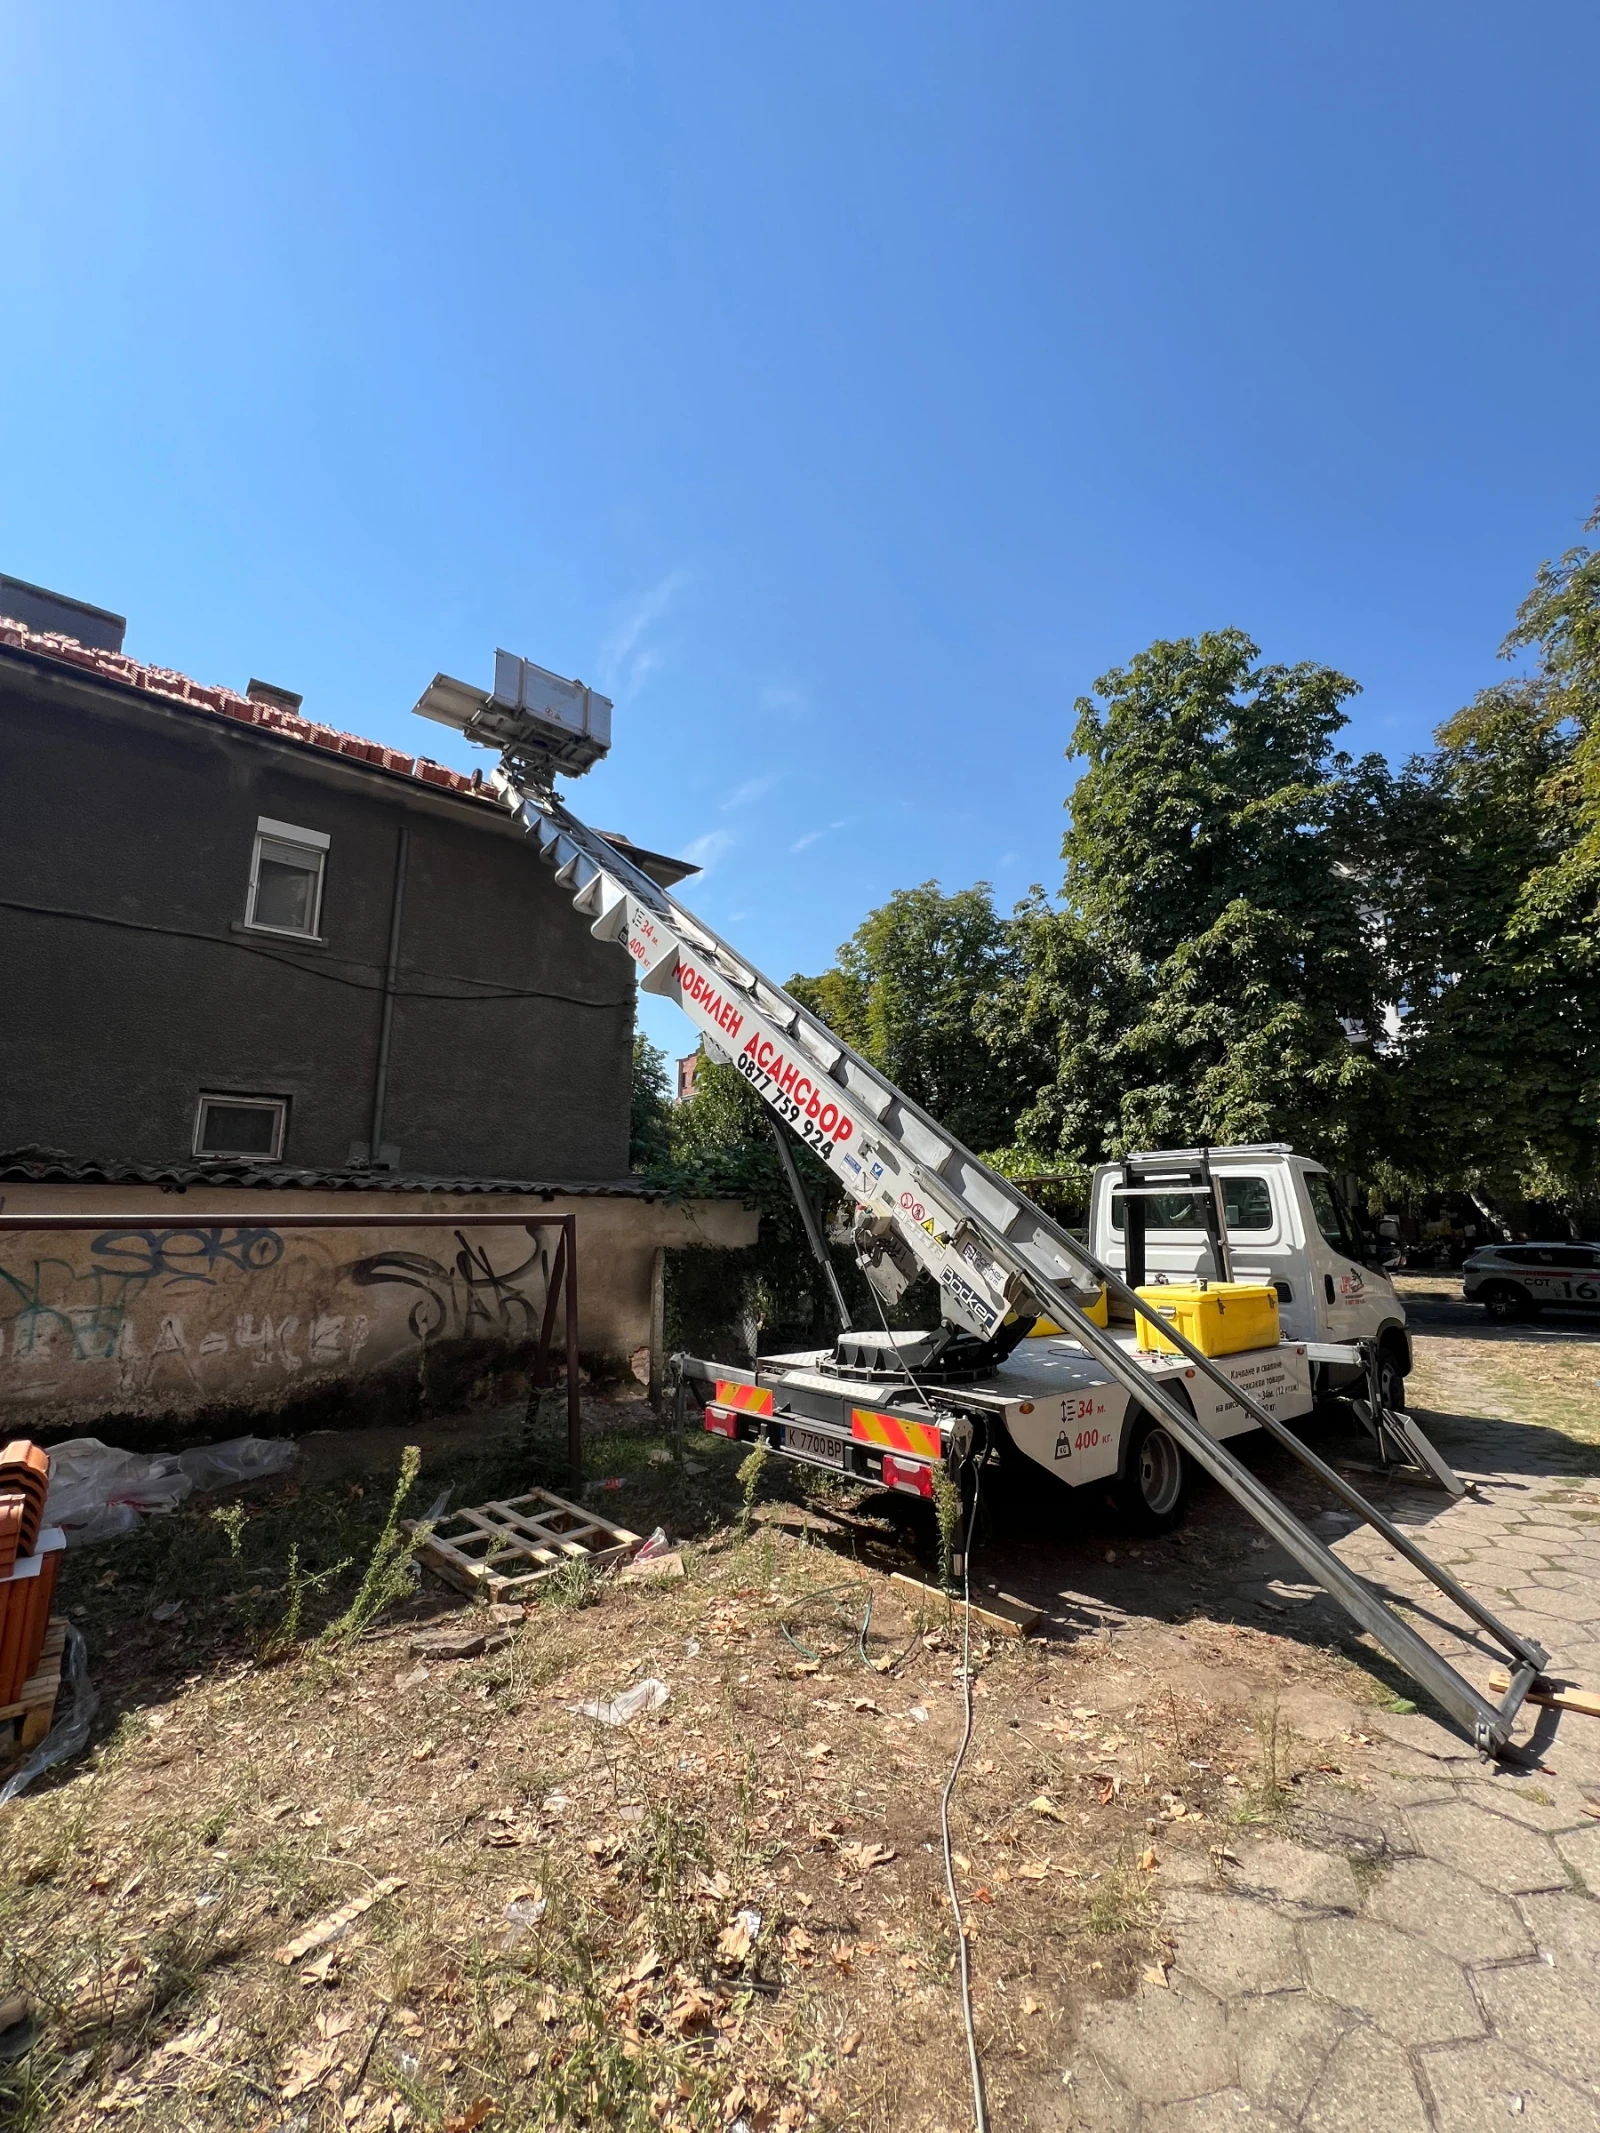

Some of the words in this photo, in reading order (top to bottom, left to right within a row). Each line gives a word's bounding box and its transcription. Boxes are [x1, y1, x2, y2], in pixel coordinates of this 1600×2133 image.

[640, 919, 655, 938] 34
[628, 938, 646, 959] 400
[671, 957, 745, 1039] МОБИЛЕН
[743, 1031, 854, 1143] АСАНСЬОР
[737, 1052, 773, 1092] 0877
[771, 1087, 800, 1123] 759
[801, 1119, 835, 1160] 924
[940, 1264, 996, 1322] Böcker
[1561, 1280, 1600, 1300] 16
[1077, 1398, 1094, 1419] 34
[1096, 1404, 1106, 1415] м.
[1215, 1402, 1224, 1413] на
[789, 1428, 796, 1446] K
[1074, 1428, 1099, 1451] 400
[1101, 1433, 1113, 1445] кг.
